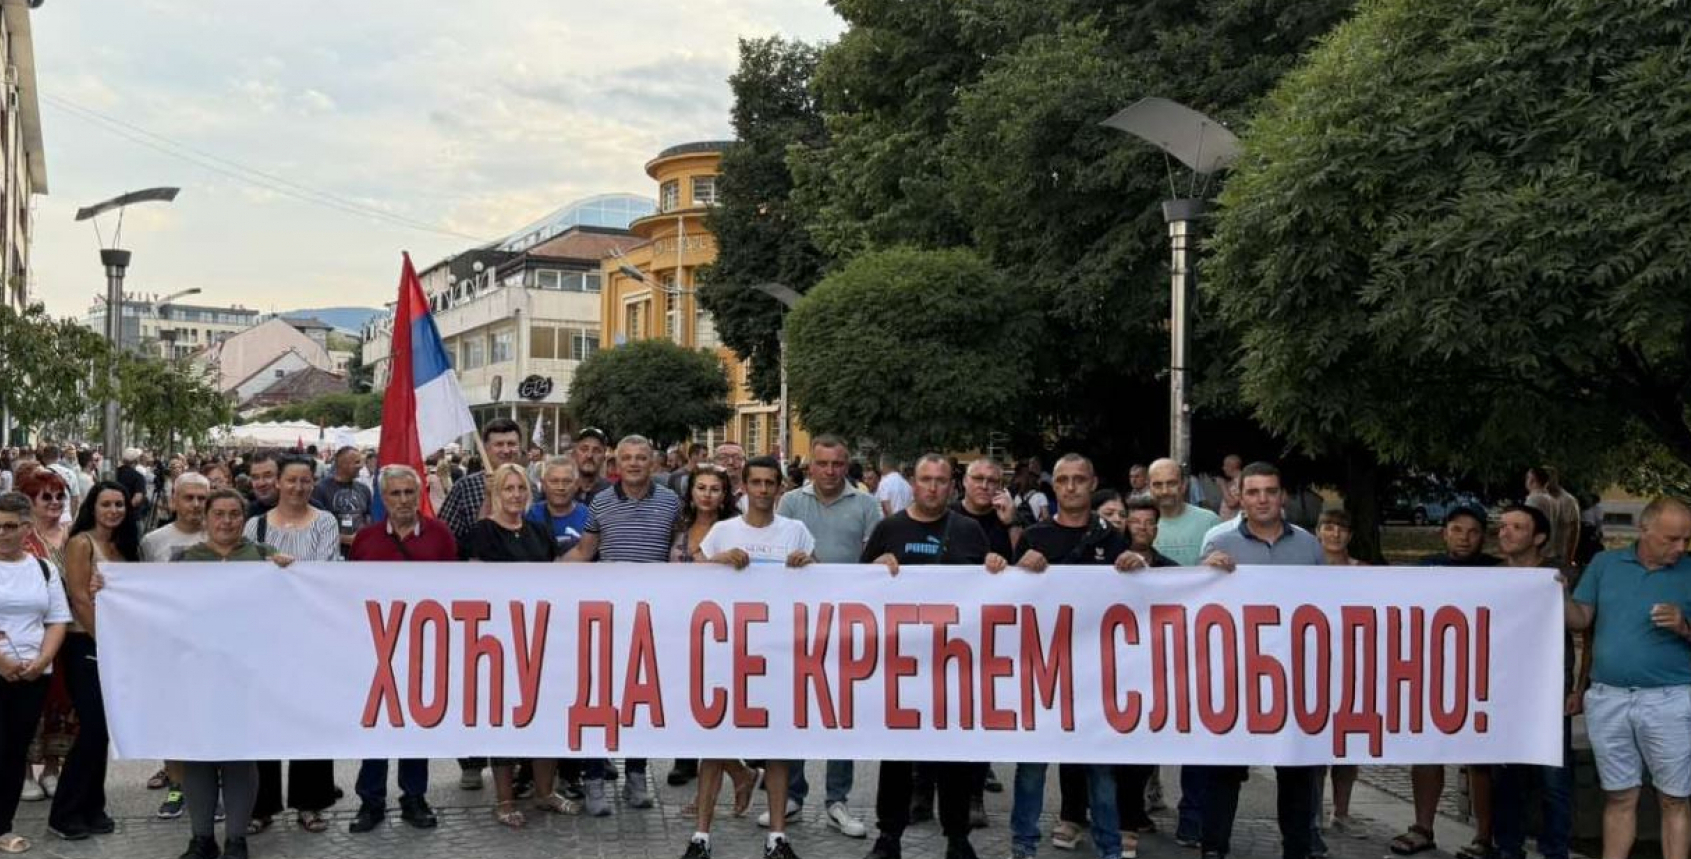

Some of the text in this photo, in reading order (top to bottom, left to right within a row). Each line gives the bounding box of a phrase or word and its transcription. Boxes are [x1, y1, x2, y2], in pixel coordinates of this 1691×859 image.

[361, 600, 1490, 758] ХОЋУ ДА СЕ КРЕЋЕМ СЛОБОДНО!
